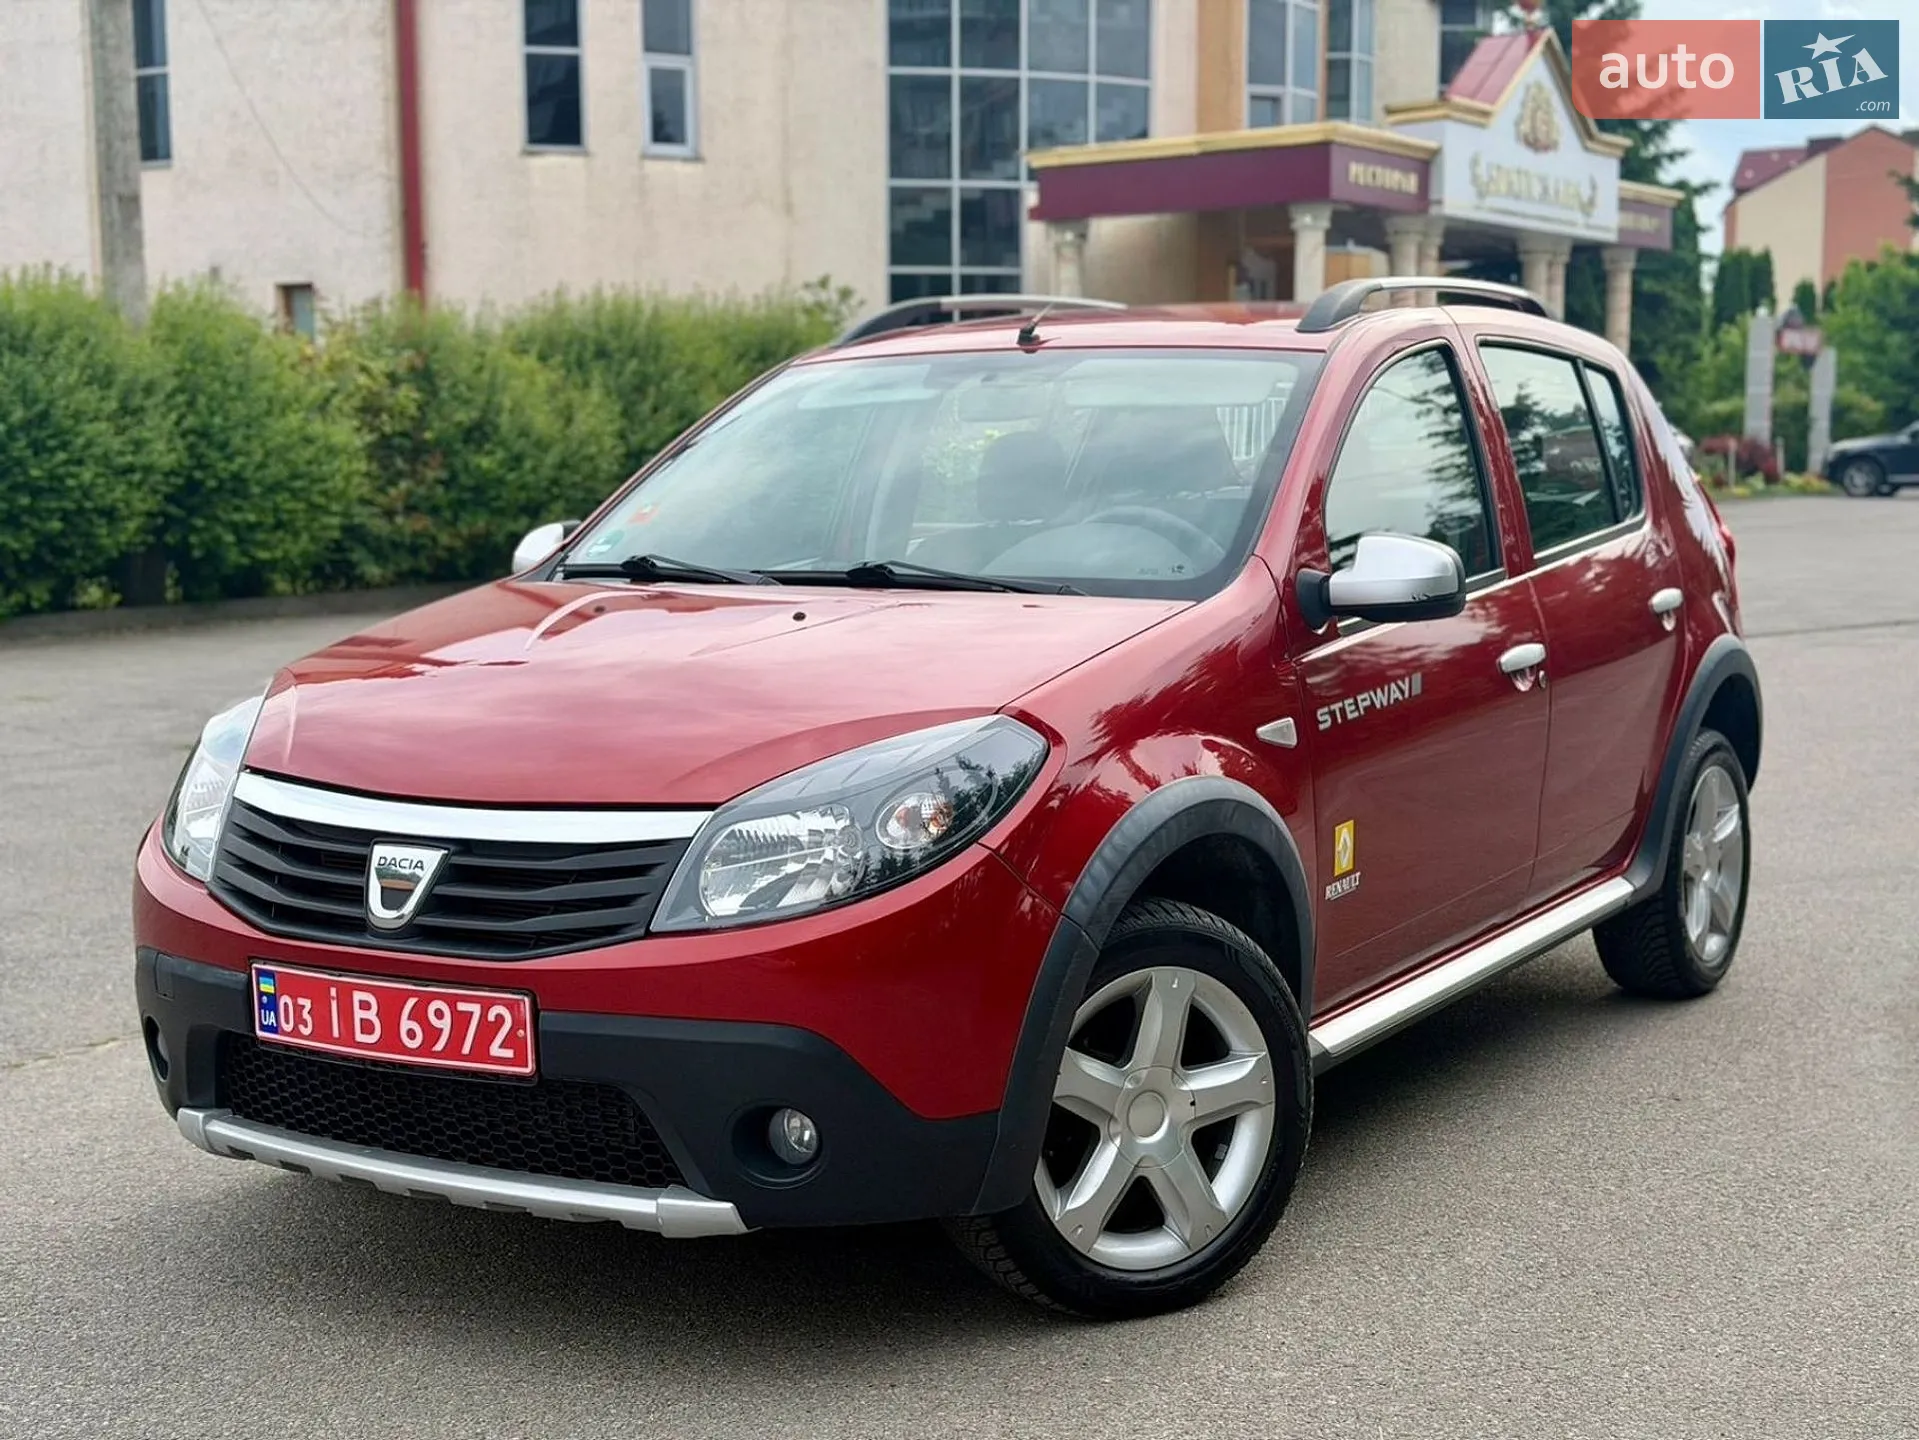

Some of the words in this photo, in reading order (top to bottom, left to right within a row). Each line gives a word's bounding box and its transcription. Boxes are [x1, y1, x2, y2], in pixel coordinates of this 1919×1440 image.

[1316, 676, 1410, 731] STEPWAY
[377, 856, 425, 872] DACIA
[1325, 871, 1361, 900] RENAULT
[261, 1009, 277, 1027] UA
[279, 994, 313, 1036] 03
[400, 997, 515, 1059] 6972
